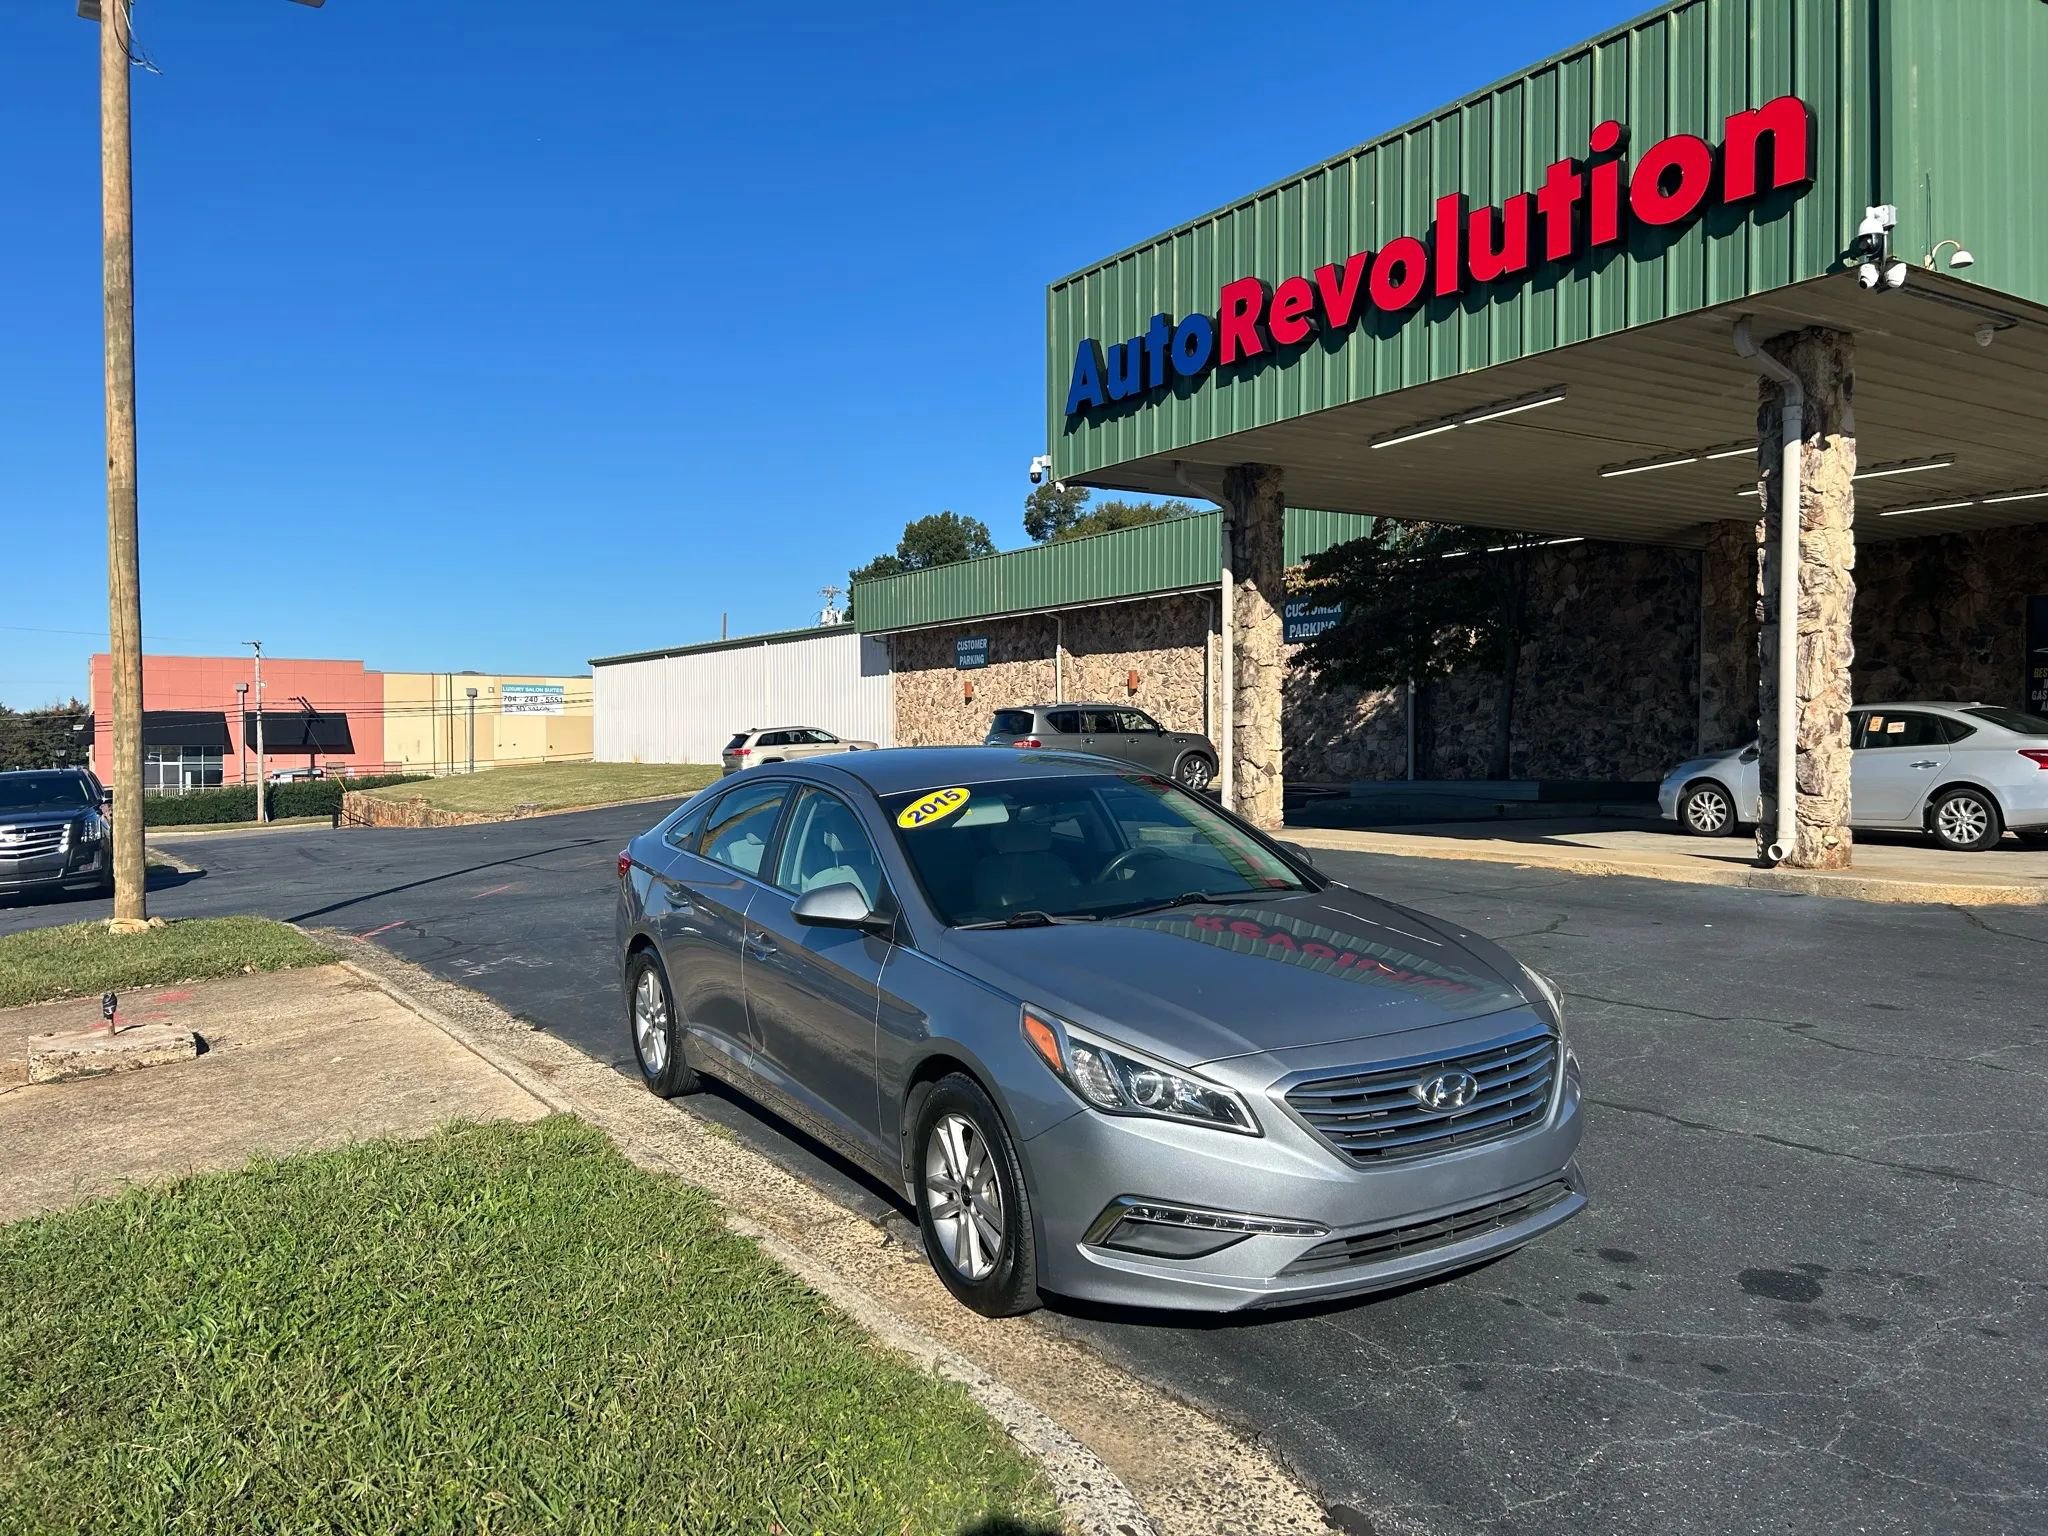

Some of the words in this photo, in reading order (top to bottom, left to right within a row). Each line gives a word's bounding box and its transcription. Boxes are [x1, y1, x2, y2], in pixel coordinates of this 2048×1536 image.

[957, 639, 988, 651] CUSTOMER
[960, 654, 985, 666] PARKING
[503, 695, 517, 703] 704
[545, 696, 563, 704] 5551
[907, 790, 961, 824] 2015
